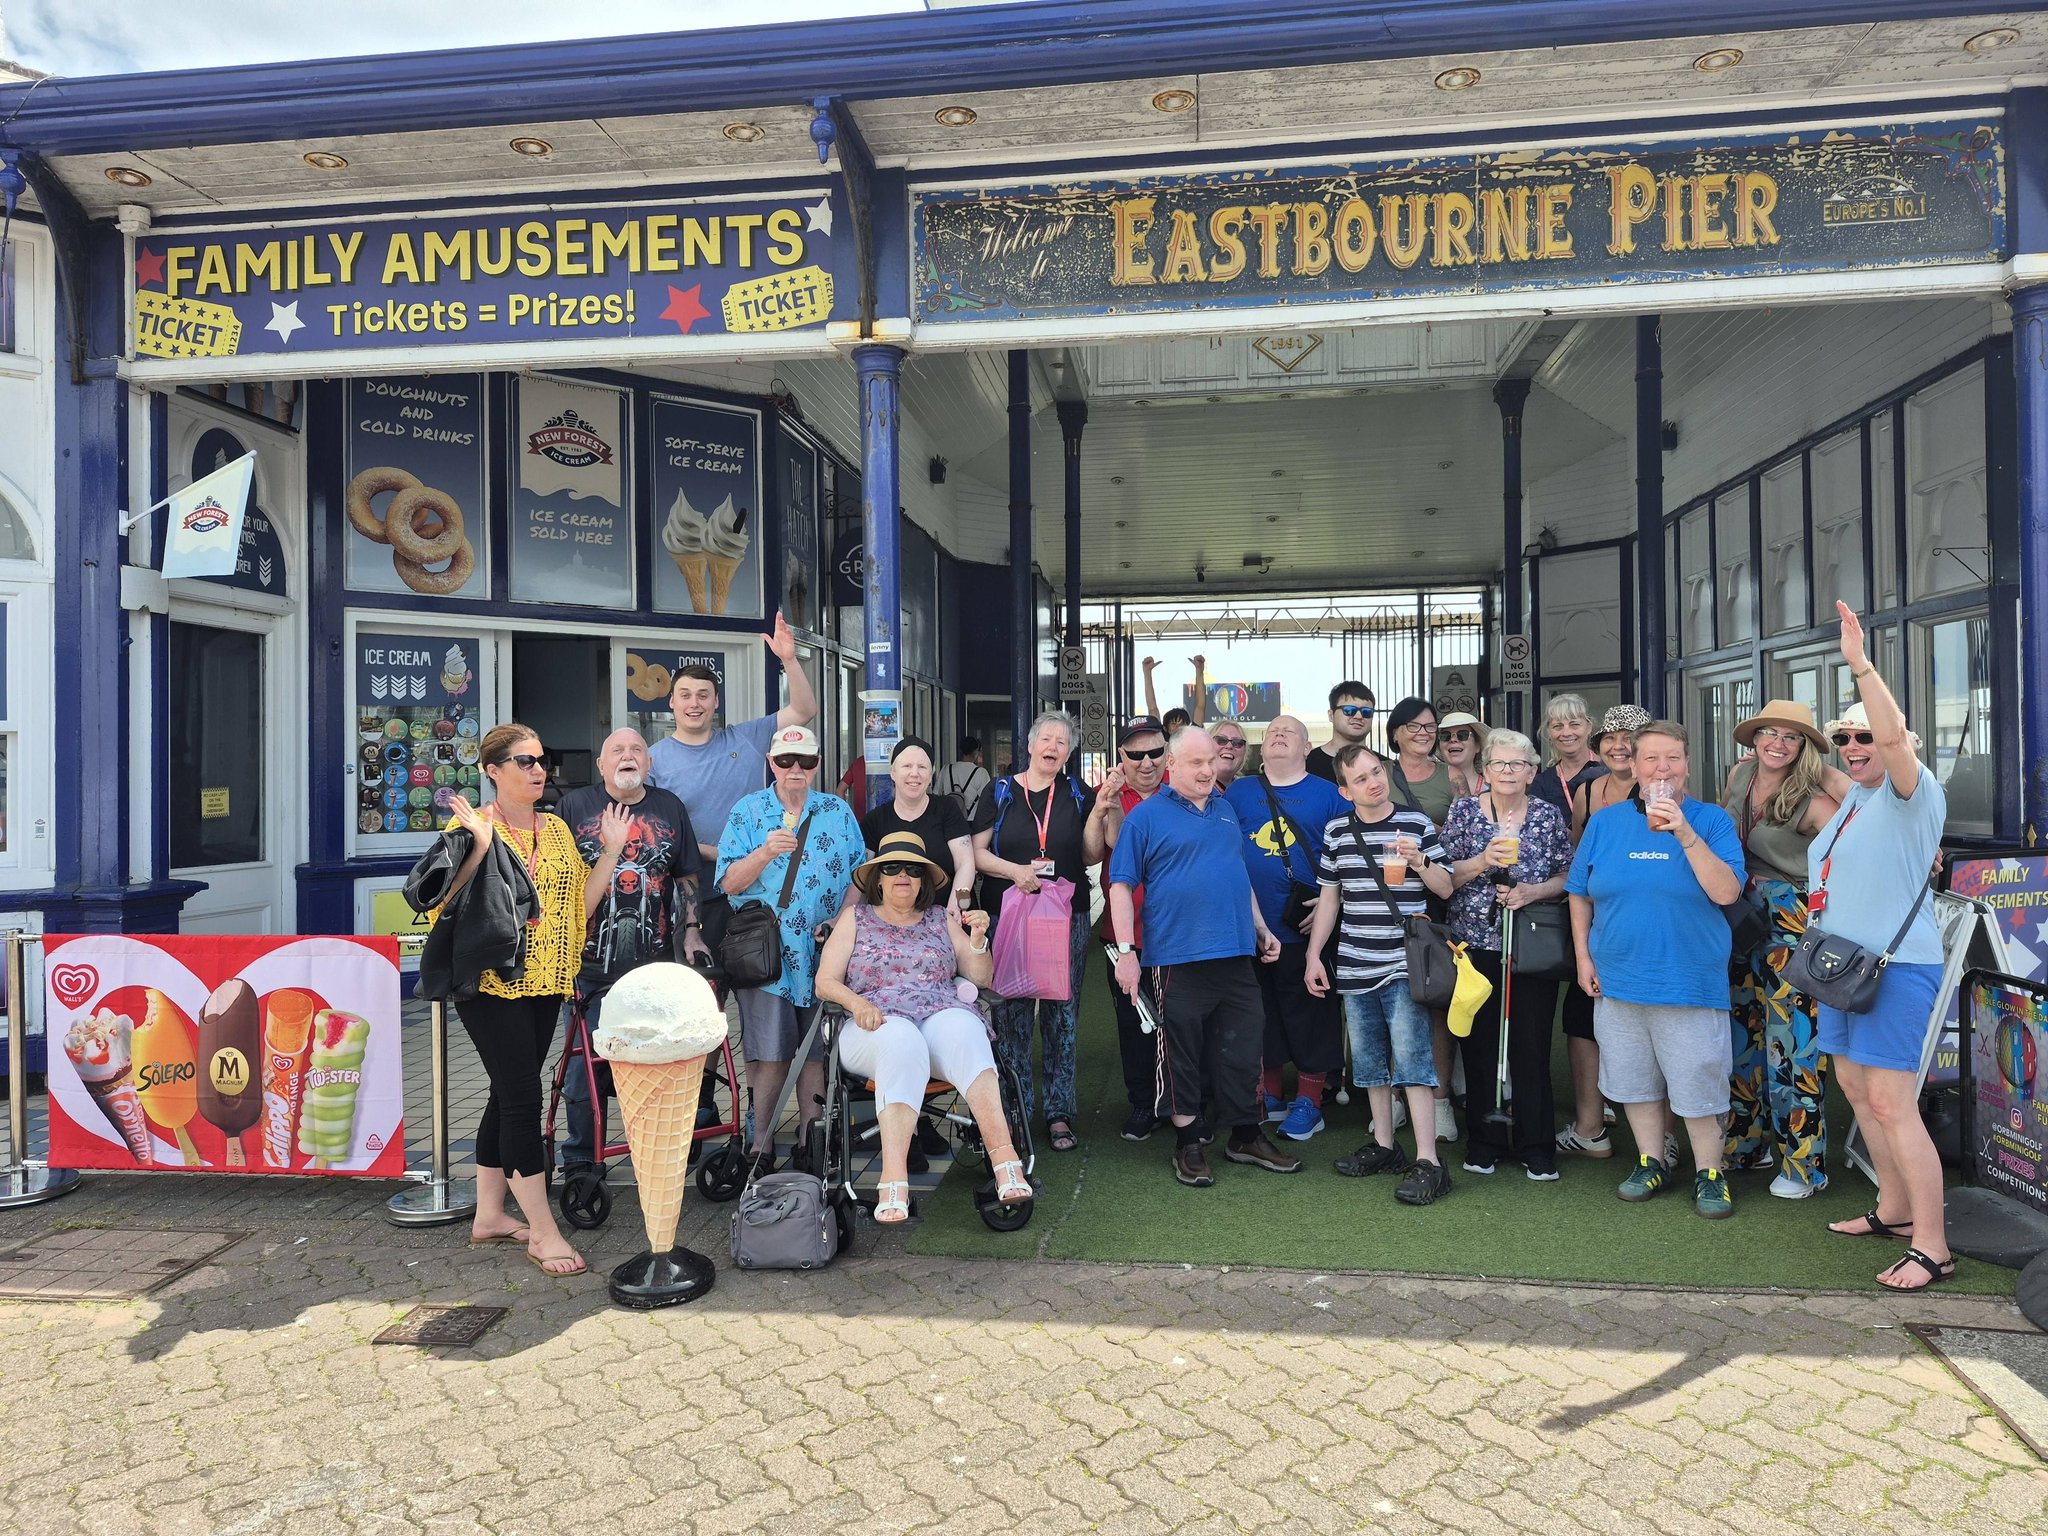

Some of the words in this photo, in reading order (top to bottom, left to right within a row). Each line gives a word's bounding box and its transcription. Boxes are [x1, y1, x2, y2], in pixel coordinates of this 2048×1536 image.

[1110, 184, 1575, 287] EASTBOURNE
[1605, 163, 1781, 254] PIER
[167, 231, 363, 297] FAMILY
[381, 208, 805, 286] AMUSEMENTS
[326, 299, 467, 336] Tickets
[478, 304, 496, 321] =
[508, 288, 635, 327] Prizes!
[722, 300, 734, 327] 01234
[739, 285, 817, 320] TICKET
[139, 311, 223, 348] TICKET
[227, 324, 240, 355] 01234
[366, 380, 469, 407] DOUGHNUTS
[400, 405, 434, 421] AND
[360, 419, 405, 436] COLD
[412, 425, 474, 445] DRINKS
[535, 431, 560, 445] NEW
[564, 431, 606, 453] FOREST
[550, 450, 563, 462] ICE
[565, 456, 591, 465] CREAM
[664, 436, 745, 459] SOFT-SERVE
[669, 454, 691, 468] ICE
[695, 458, 742, 475] CREAM
[187, 512, 203, 523] NEW
[203, 509, 226, 520] FOREST
[253, 517, 269, 533] YOUR
[530, 508, 554, 522] ICE
[560, 512, 613, 529] CREAM
[529, 526, 569, 540] SOLD
[575, 531, 614, 545] HERE
[365, 649, 385, 665] ICE
[388, 650, 432, 667] CREAM
[1061, 681, 1085, 689] DOGS
[1505, 671, 1530, 680] DOGS
[1629, 851, 1670, 860] adidas
[1981, 866, 2030, 885] FAMILY
[1997, 1000, 2015, 1013] GLOW
[2016, 1007, 2024, 1016] IN
[2039, 1014, 2048, 1022] DA
[136, 1061, 196, 1092] SOLERO
[218, 1056, 241, 1079] M
[1992, 1122, 2043, 1152] @ORBMINIGOLF
[1993, 1134, 2042, 1162] #ORBMINIGOLF
[1998, 1149, 2036, 1180] PRIZES
[1987, 1164, 2048, 1202] COMPETITIONS
